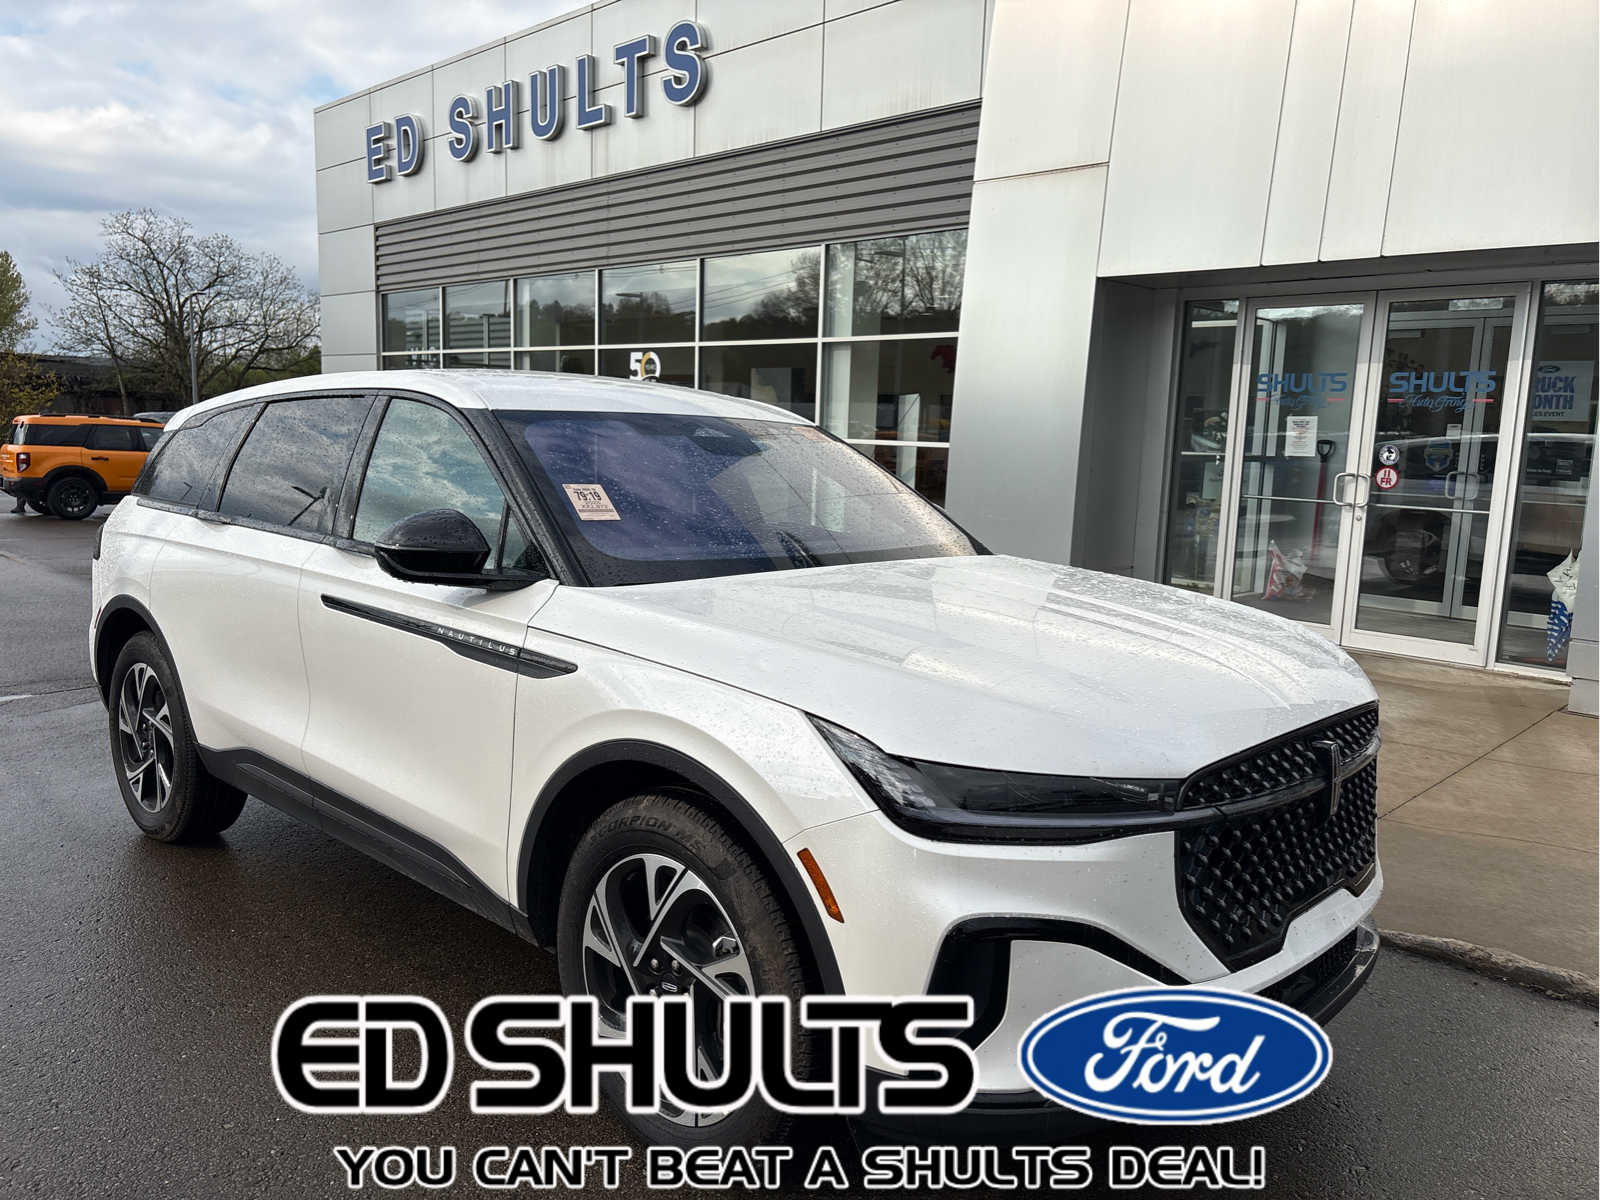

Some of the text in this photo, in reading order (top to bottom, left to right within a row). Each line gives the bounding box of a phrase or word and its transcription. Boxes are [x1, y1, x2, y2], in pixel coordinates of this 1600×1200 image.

[366, 20, 709, 184] ED SHULTS
[1256, 372, 1348, 393] SHULTS
[1389, 370, 1497, 393] SHULTS
[1380, 477, 1392, 486] FR
[437, 627, 516, 655] NAUTILUS
